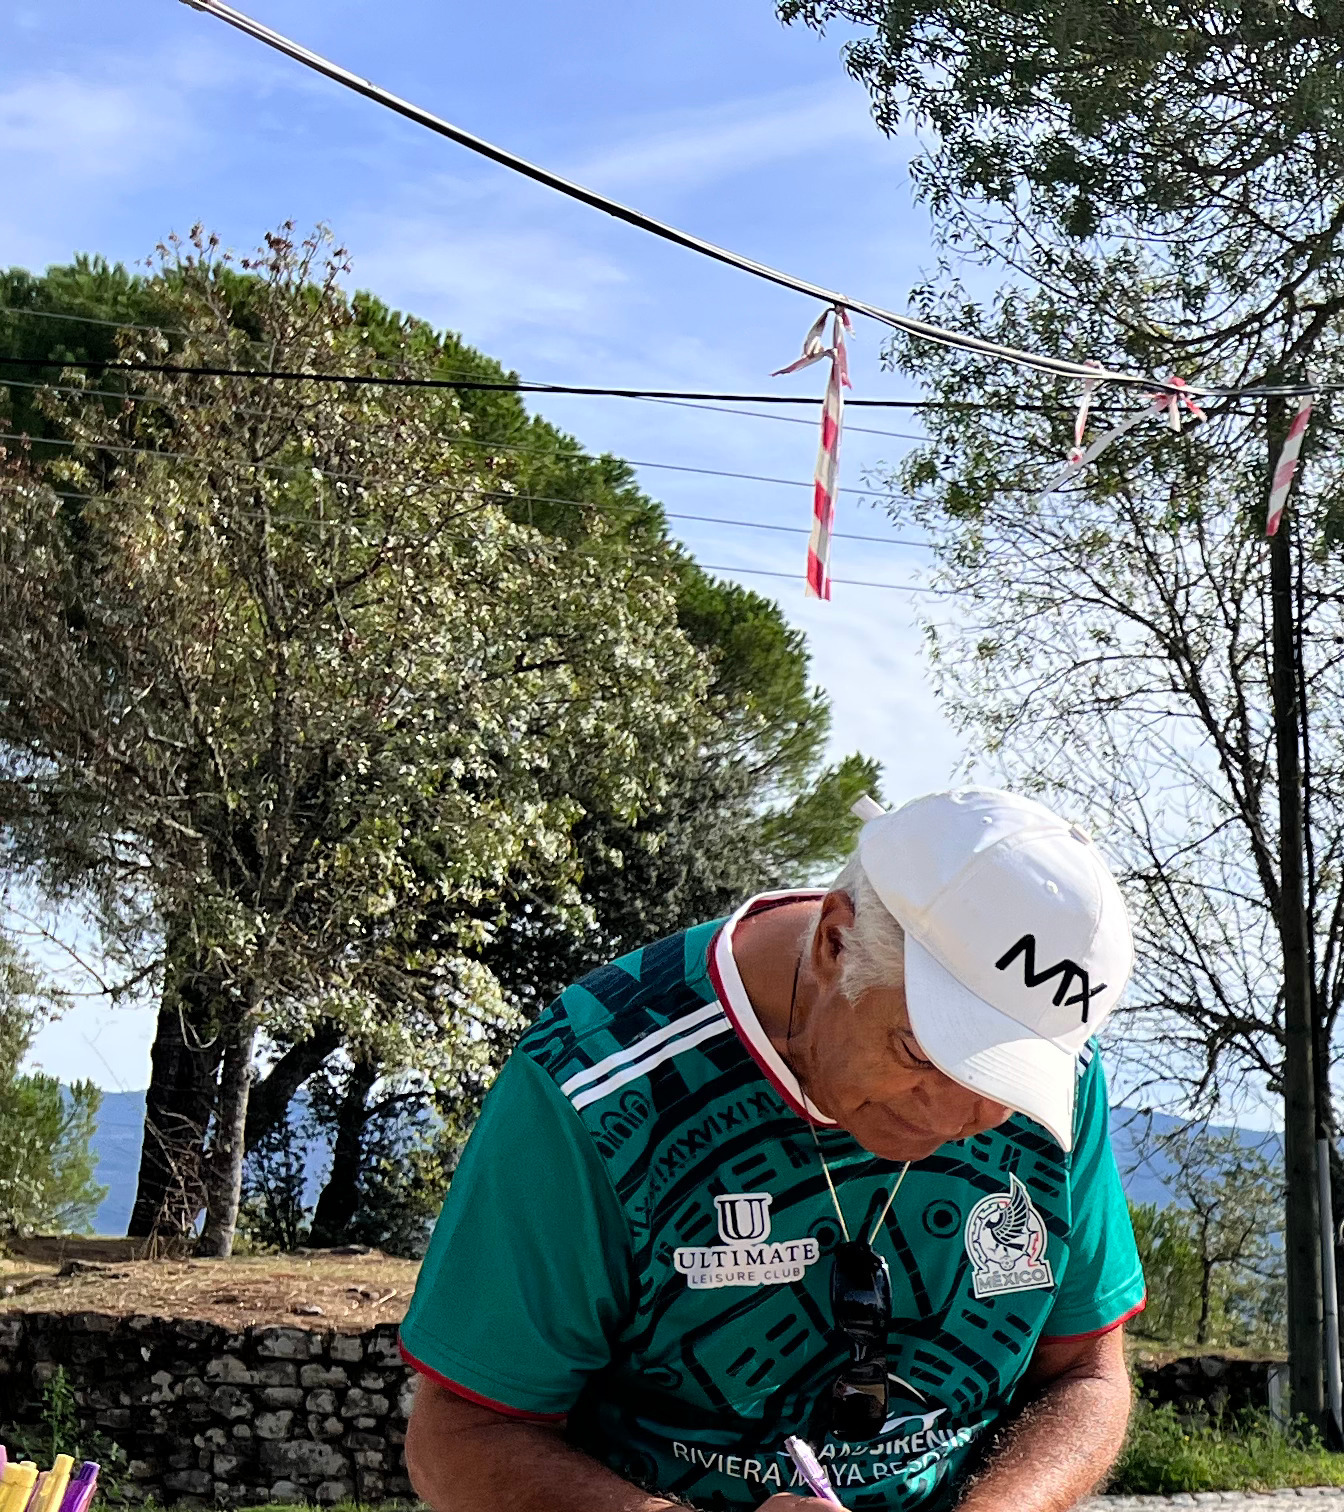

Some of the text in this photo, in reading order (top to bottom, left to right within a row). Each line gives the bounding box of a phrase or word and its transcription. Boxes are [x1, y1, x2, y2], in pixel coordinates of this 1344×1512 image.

[678, 1244, 816, 1269] ULTIMATE
[692, 1267, 801, 1284] LEISURE CLUB
[978, 1269, 1045, 1290] MÉXICO
[672, 1442, 782, 1487] RIVIERA
